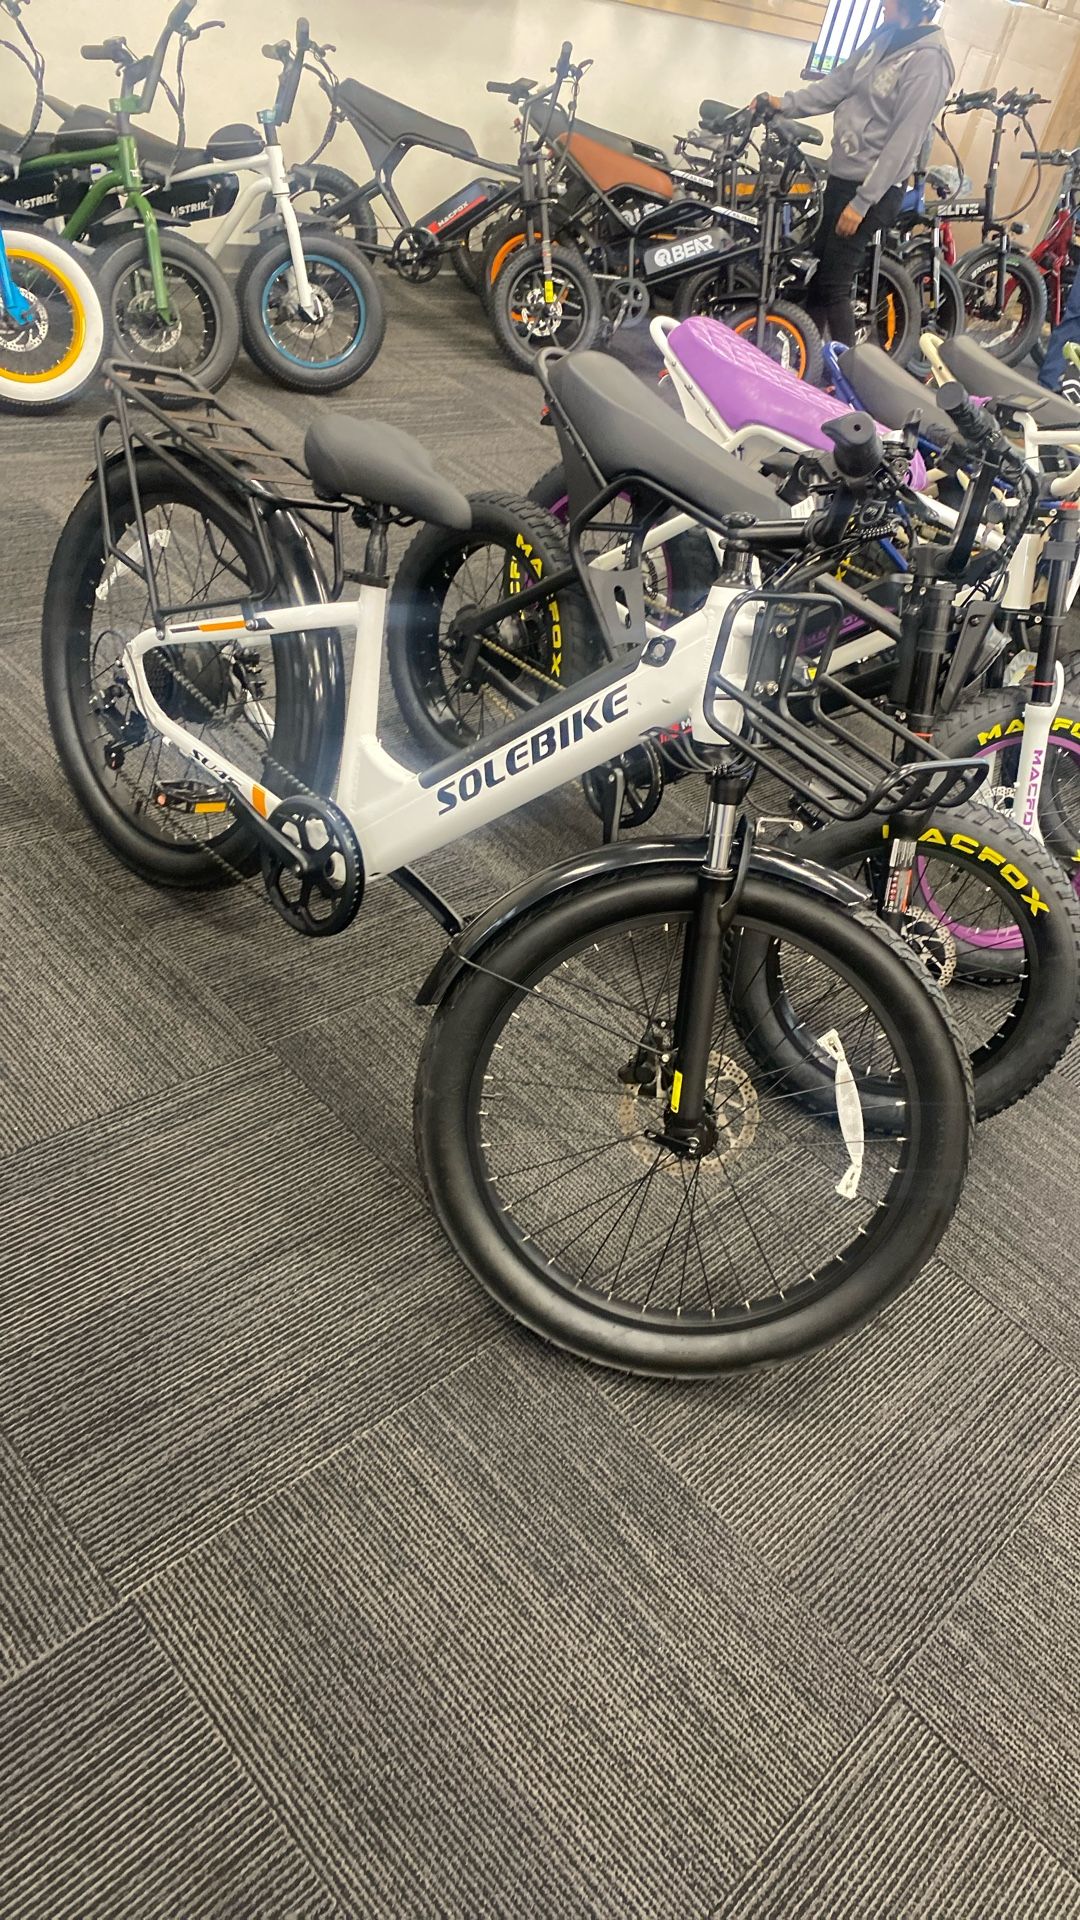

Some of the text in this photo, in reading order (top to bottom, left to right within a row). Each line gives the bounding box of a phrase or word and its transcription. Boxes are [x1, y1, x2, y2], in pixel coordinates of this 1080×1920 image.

[23, 193, 57, 210] STRIK
[178, 201, 213, 216] STRIK
[515, 532, 562, 678] MAFOX
[437, 683, 629, 816] SOLEBIKE
[1022, 749, 1044, 833] MACFO
